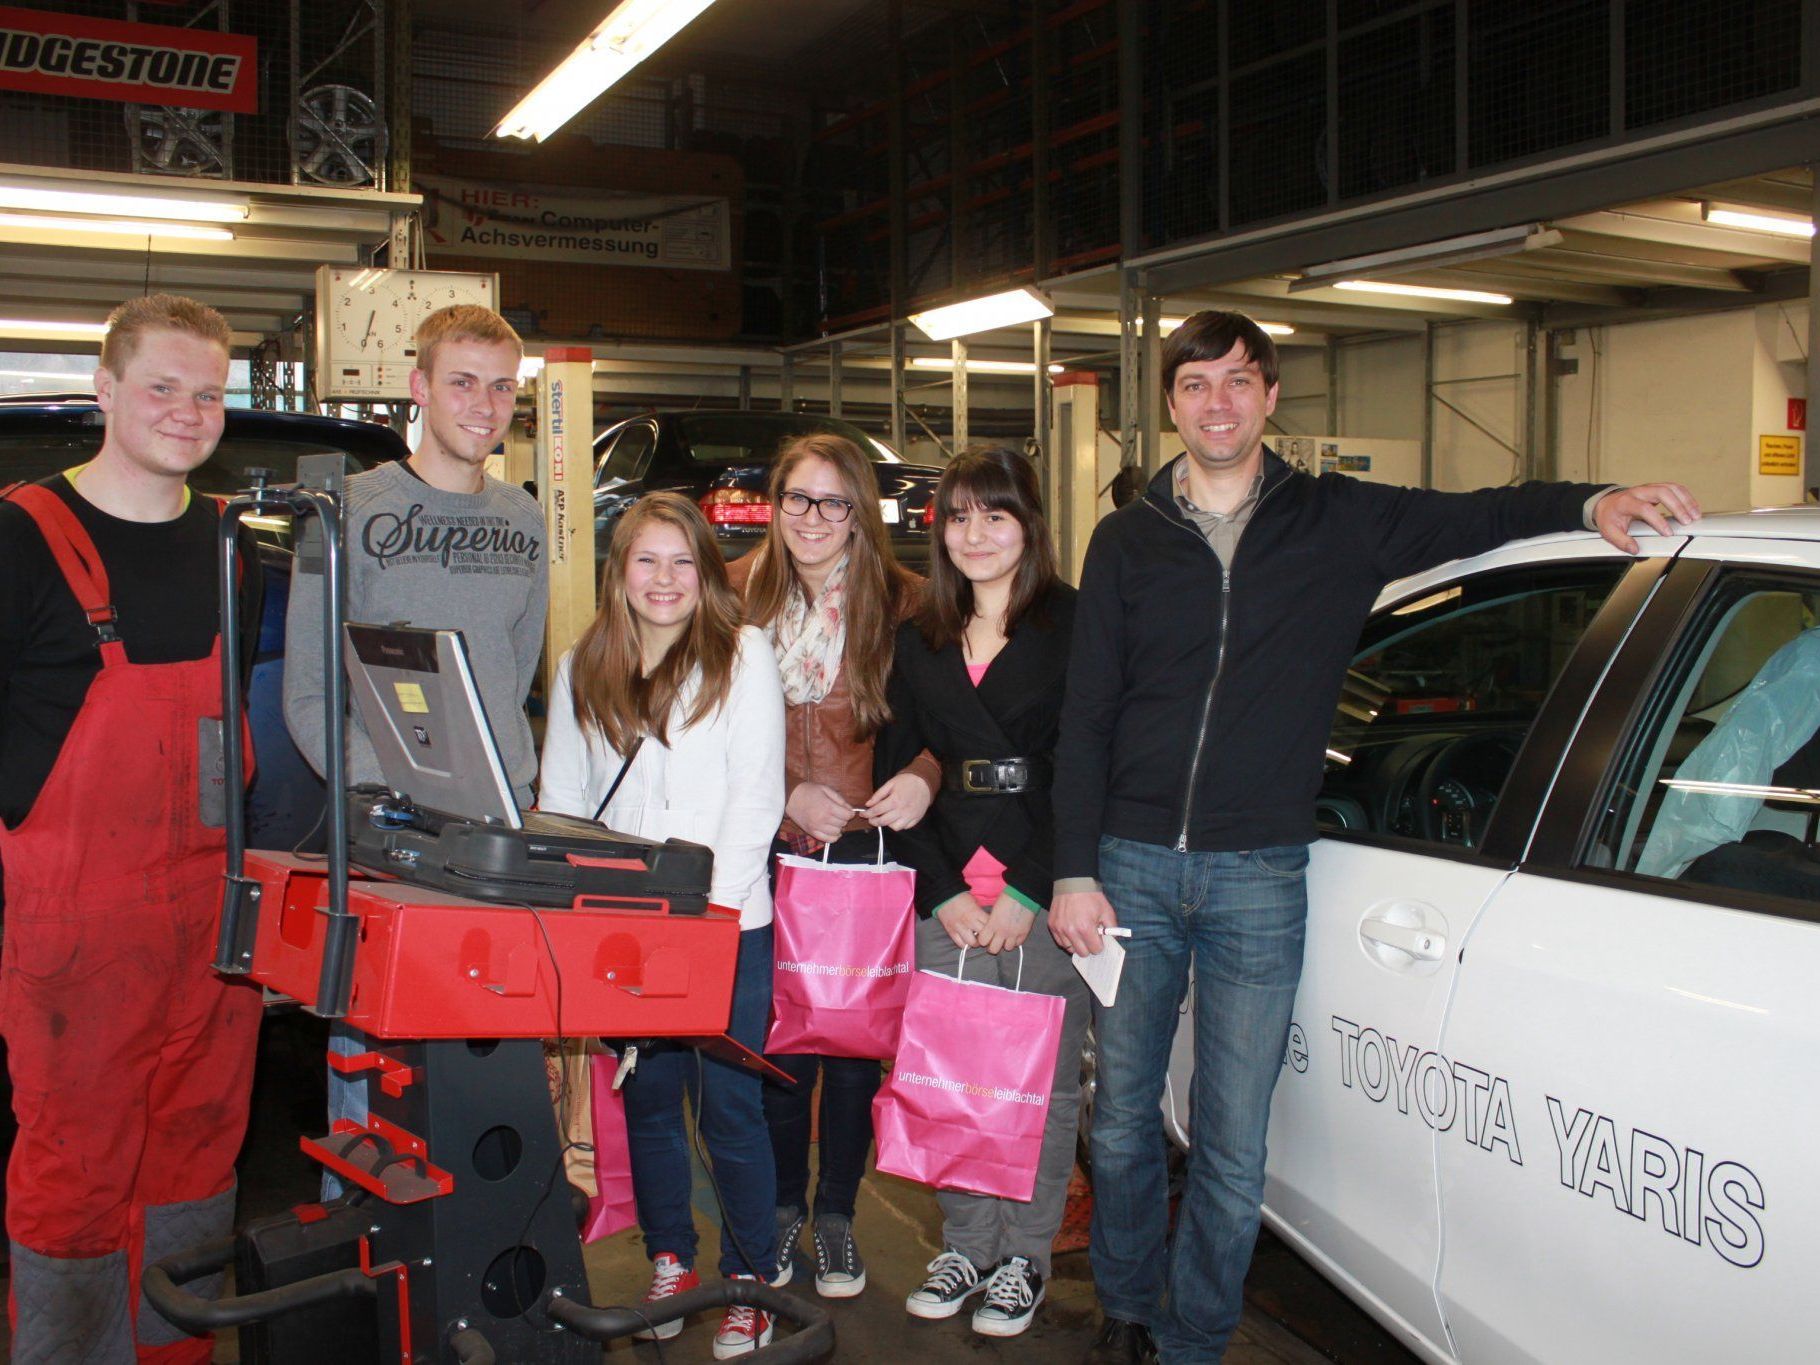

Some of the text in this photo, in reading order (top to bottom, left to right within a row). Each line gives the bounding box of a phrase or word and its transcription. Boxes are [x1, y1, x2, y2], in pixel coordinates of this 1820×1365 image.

[461, 188, 539, 209] HIER:
[541, 211, 659, 234] Computer-
[461, 226, 659, 259] Achsvermessung
[344, 298, 351, 306] 2
[425, 301, 432, 309] 2
[449, 290, 456, 298] 3
[551, 382, 563, 434] stertil
[362, 504, 540, 570] Superior
[898, 1071, 1045, 1106] unternehmerbörseleiblachtal
[1283, 1015, 1766, 1269] e TOYOTA YARIS
